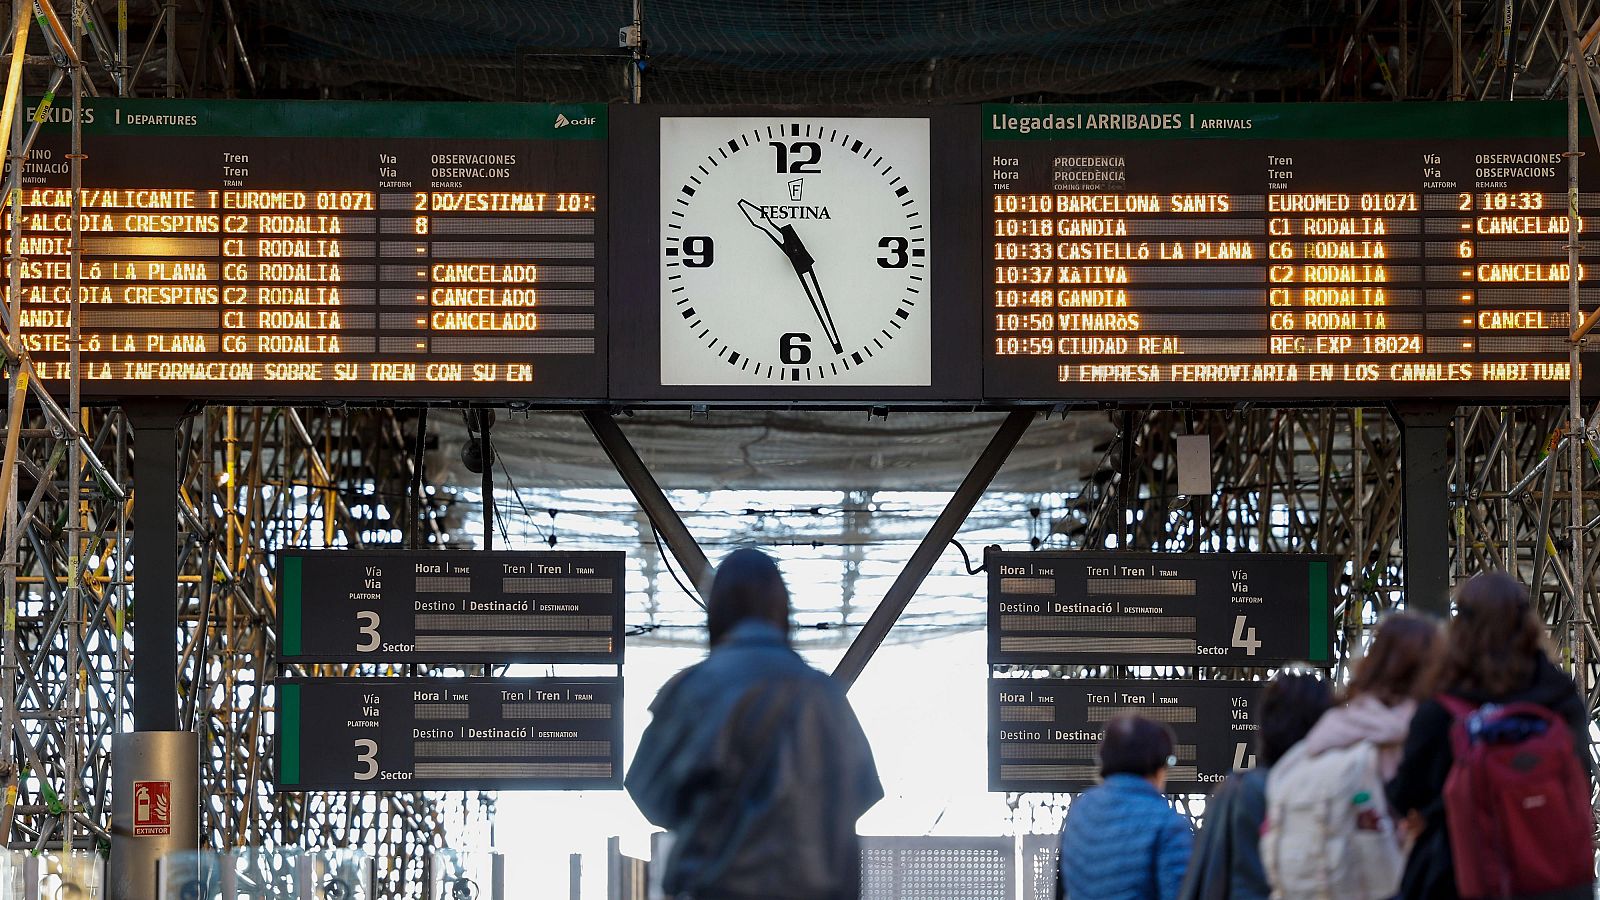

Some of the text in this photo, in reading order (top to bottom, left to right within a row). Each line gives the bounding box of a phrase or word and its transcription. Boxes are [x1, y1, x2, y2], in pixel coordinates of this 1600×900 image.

[127, 115, 197, 126] DEPARTURES
[571, 117, 596, 125] adif
[992, 114, 1252, 133] Llegadas ARRIBADES ARRIVALS
[223, 153, 249, 163] Tren
[431, 154, 516, 165] OBSERVACIONES
[768, 141, 821, 174] 12
[993, 156, 1019, 166] Hora
[1054, 157, 1125, 167] PROCEDENCIA
[1268, 155, 1293, 166] Tren
[1423, 153, 1441, 165] Vía
[1475, 153, 1561, 164] OBSERVACIONES
[223, 167, 249, 176] Tren
[379, 167, 397, 178] Via
[993, 170, 1019, 180] Hora
[1054, 169, 1125, 181] PROCEDÈNCIA
[1268, 169, 1293, 179] Tren
[1475, 167, 1556, 178] OBSERVACIONS
[224, 192, 373, 210] EUROMED 01071
[415, 193, 427, 210] 2
[994, 195, 1052, 212] 10:10
[1057, 195, 1229, 212] BARCELONA SANTS
[1269, 194, 1417, 211] EUROMED 01071
[1459, 193, 1471, 211] 2
[1482, 193, 1543, 210] 10:33
[760, 205, 831, 219] FESTINA
[125, 215, 219, 232] CRESPINS
[224, 216, 341, 234] C2 RODALIA
[415, 216, 428, 234] 8
[994, 219, 1053, 236] 10:18
[1057, 219, 1127, 236] GANDIA
[1269, 218, 1385, 235] C1 RODALIA
[223, 240, 340, 257] C1 RODALIA
[682, 236, 714, 268] 9
[876, 236, 909, 268] 3
[994, 243, 1053, 260] 10:33
[1057, 242, 1252, 260] CASTELLó LA PLANA
[1269, 242, 1385, 259] C6 RODALIA
[1459, 241, 1472, 258] 6
[113, 263, 207, 280] LA PLANA
[224, 264, 341, 281] C6 RODALIA
[432, 265, 537, 282] CANCELADO
[995, 267, 1053, 284] 10:37
[1270, 265, 1386, 283] C2 RODALIA
[124, 287, 218, 304] CRESPINS
[223, 288, 341, 305] C2 RODALIA
[431, 288, 536, 306] CANCELADO
[995, 290, 1053, 307] 10:48
[1058, 290, 1127, 307] GANDIA
[1270, 289, 1385, 306] C1 RODALIA
[223, 311, 341, 329] C1 RODALIA
[432, 313, 537, 330] CANCELADO
[995, 314, 1053, 331] 10:50
[1271, 313, 1386, 330] C6 RODALIA
[112, 334, 206, 352] LA PLANA
[223, 336, 340, 353] C6 RODALIA
[779, 332, 812, 365] 6
[995, 338, 1053, 355] 10:59
[1058, 338, 1184, 355] CIUDAD REAL
[1270, 337, 1421, 354] REG.EXP 18024
[88, 362, 112, 380] LA
[124, 363, 253, 380] INFORMACION
[264, 363, 323, 381] SOBRE
[334, 363, 358, 381] SU
[371, 364, 416, 381] TREN
[426, 364, 462, 381] CON
[472, 364, 497, 381] SU
[1080, 364, 1473, 382] EMPRESA FERROVIARIA EN LOS CANALES
[365, 565, 382, 577] Vía
[415, 563, 441, 573] Hora
[503, 564, 526, 574] Tren
[537, 564, 562, 574] Tren
[1000, 565, 1025, 575] Hora
[1087, 566, 1109, 576] Tren
[1121, 566, 1145, 576] Tren
[1231, 569, 1248, 580] Vía
[364, 579, 381, 589] Via
[1231, 582, 1248, 593] Via
[414, 601, 455, 611] Destino
[470, 600, 528, 611] Destinació
[1000, 602, 1040, 613] Destino
[1054, 602, 1112, 614] Destinació
[356, 610, 382, 653] 3
[1231, 615, 1262, 656] 4
[382, 642, 415, 653] Sector
[1197, 645, 1229, 656] Sector
[363, 693, 380, 704] Vía
[414, 691, 439, 701] Hora
[501, 691, 524, 701] Tren
[536, 691, 560, 701] Tren
[1000, 693, 1025, 702] Hora
[1087, 693, 1110, 703] Tren
[1121, 693, 1146, 704] Tren
[1231, 696, 1248, 707] Vía
[362, 706, 379, 717] Via
[1231, 709, 1248, 720] Via
[347, 720, 379, 728] PLATFORM
[413, 728, 454, 739] Destino
[468, 727, 527, 739] Destinació
[1000, 730, 1041, 741] Destino
[353, 738, 379, 781] 3
[380, 770, 412, 780] Sector
